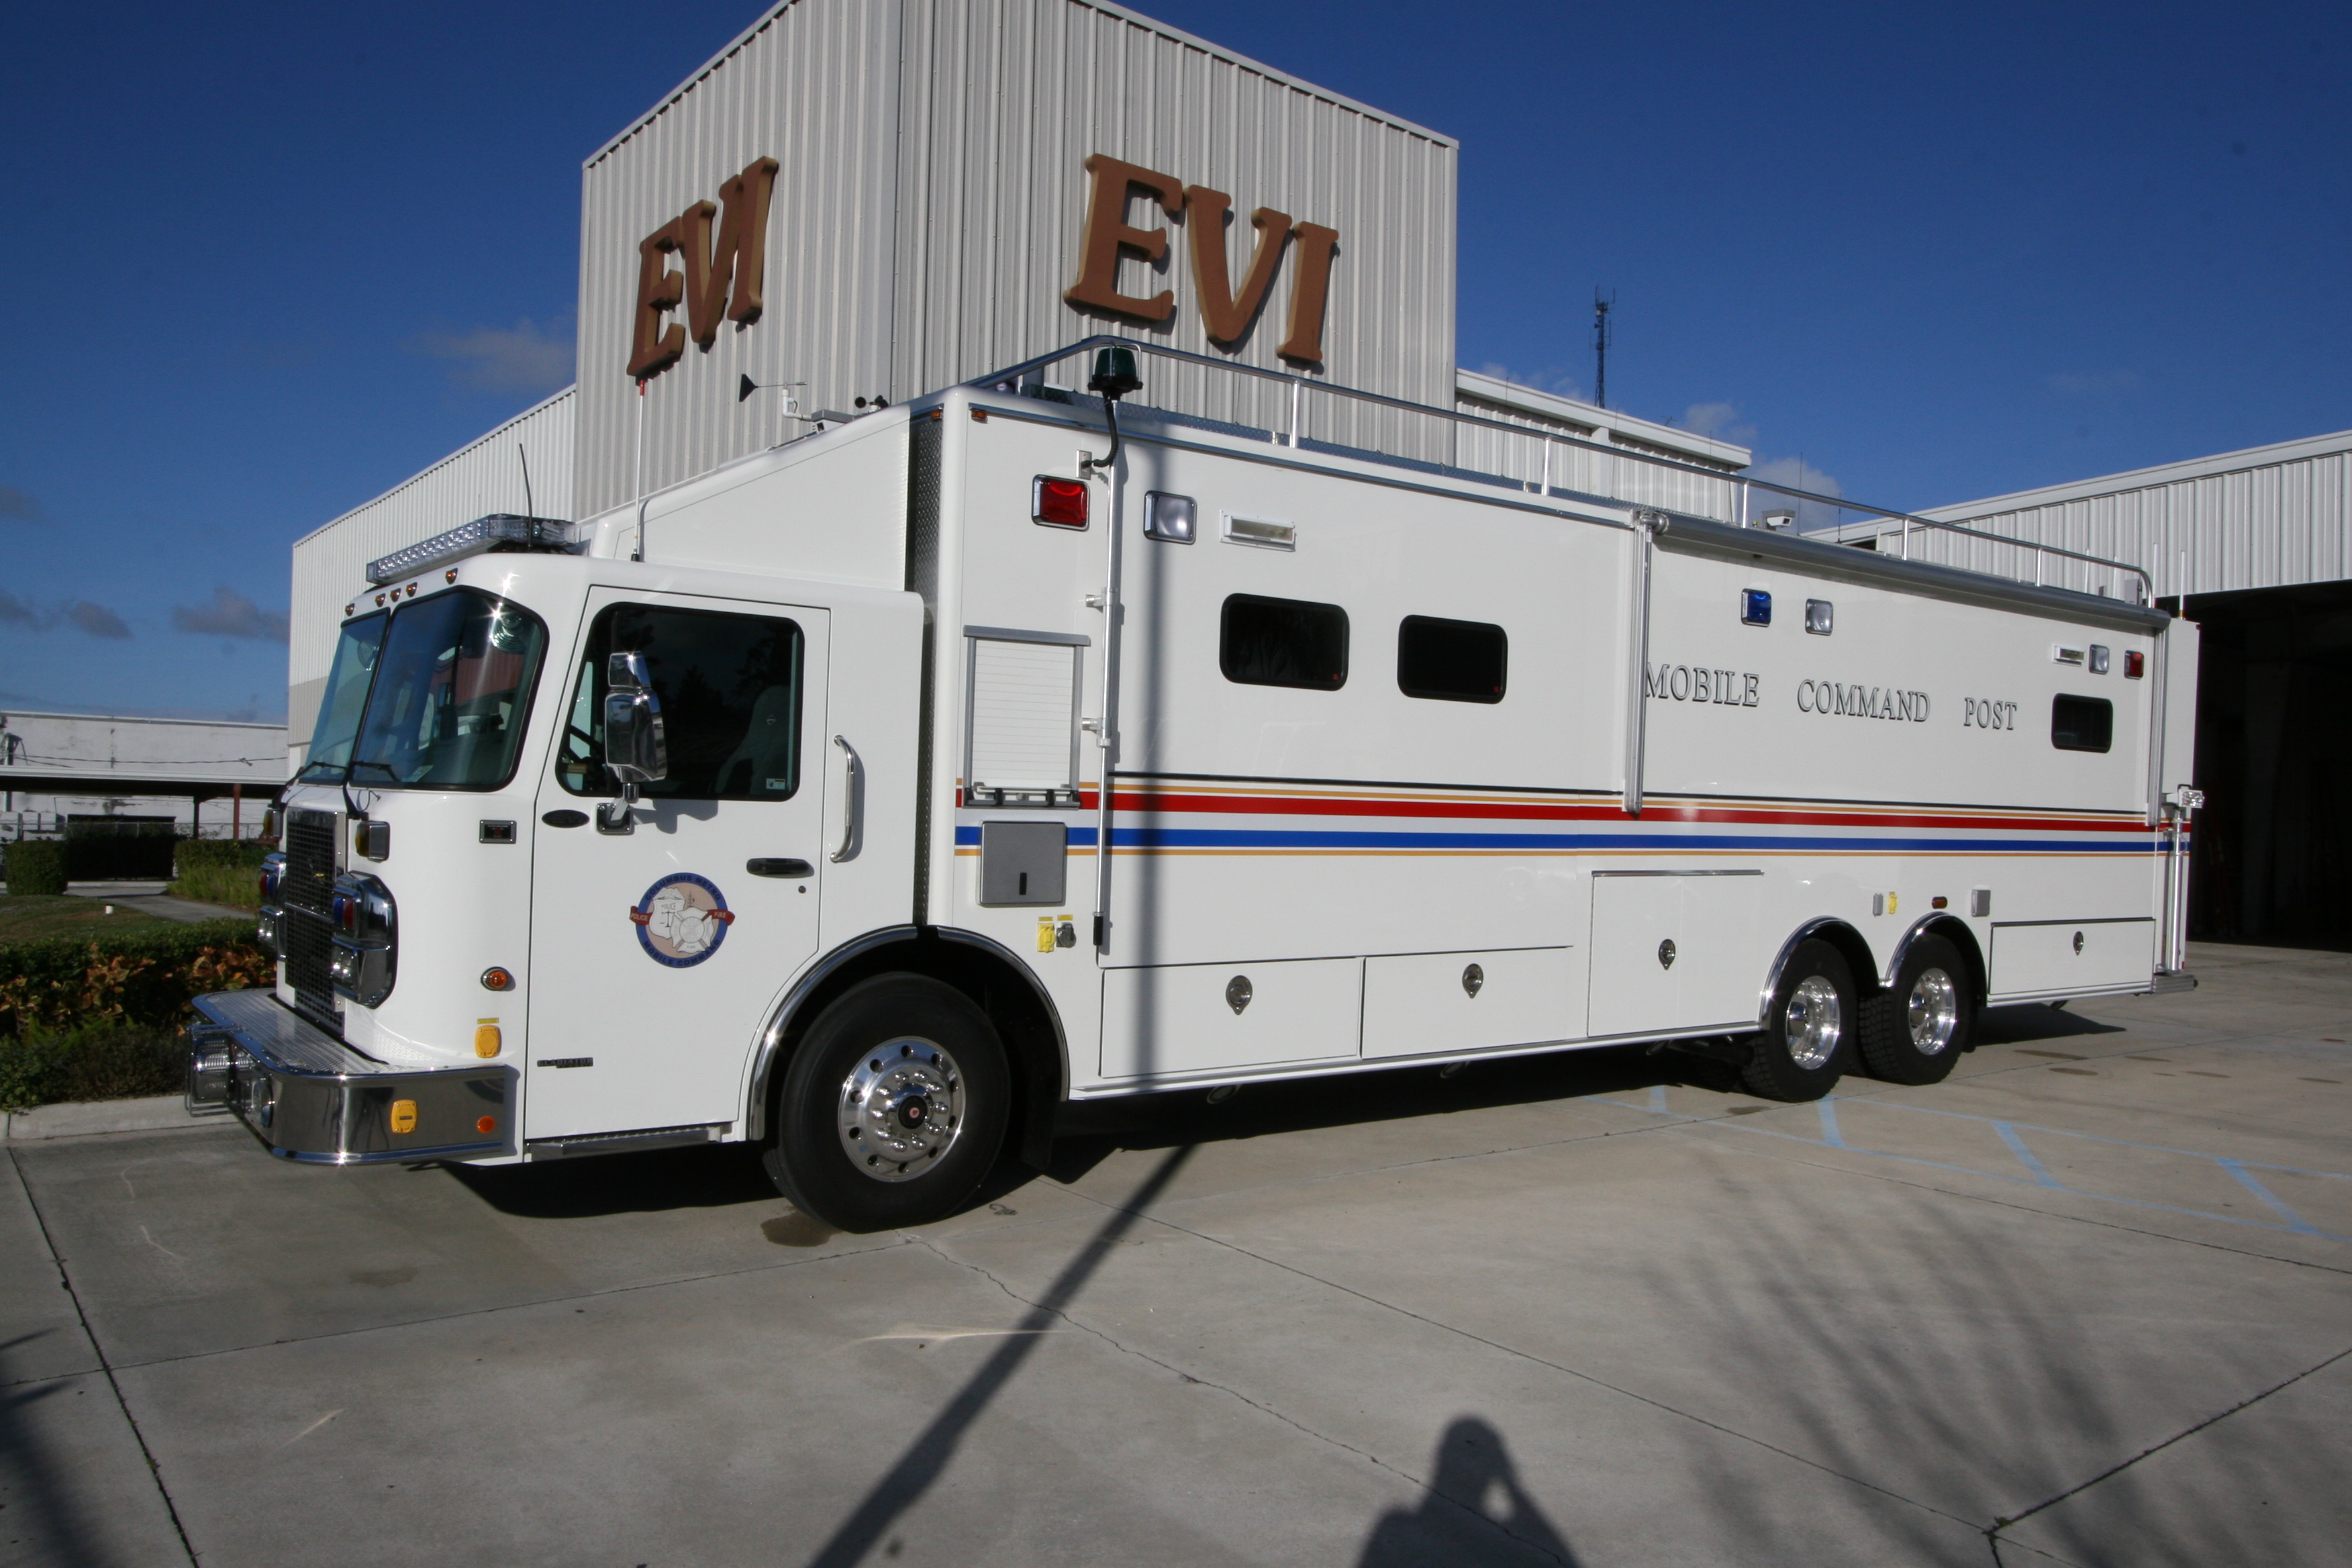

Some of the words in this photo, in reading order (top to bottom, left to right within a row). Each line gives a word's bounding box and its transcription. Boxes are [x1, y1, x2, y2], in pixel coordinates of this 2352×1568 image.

[626, 155, 779, 377] EVI
[1063, 153, 1339, 364] EVI
[1647, 662, 1760, 707] MOBILE
[1797, 679, 1930, 722] COMMAND
[1963, 697, 2018, 730] POST
[645, 875, 692, 900] COLUMBUS
[695, 877, 721, 900] METRO
[631, 913, 648, 921] POLICE
[644, 941, 673, 965] MOBILE
[677, 940, 719, 966] COMMAND
